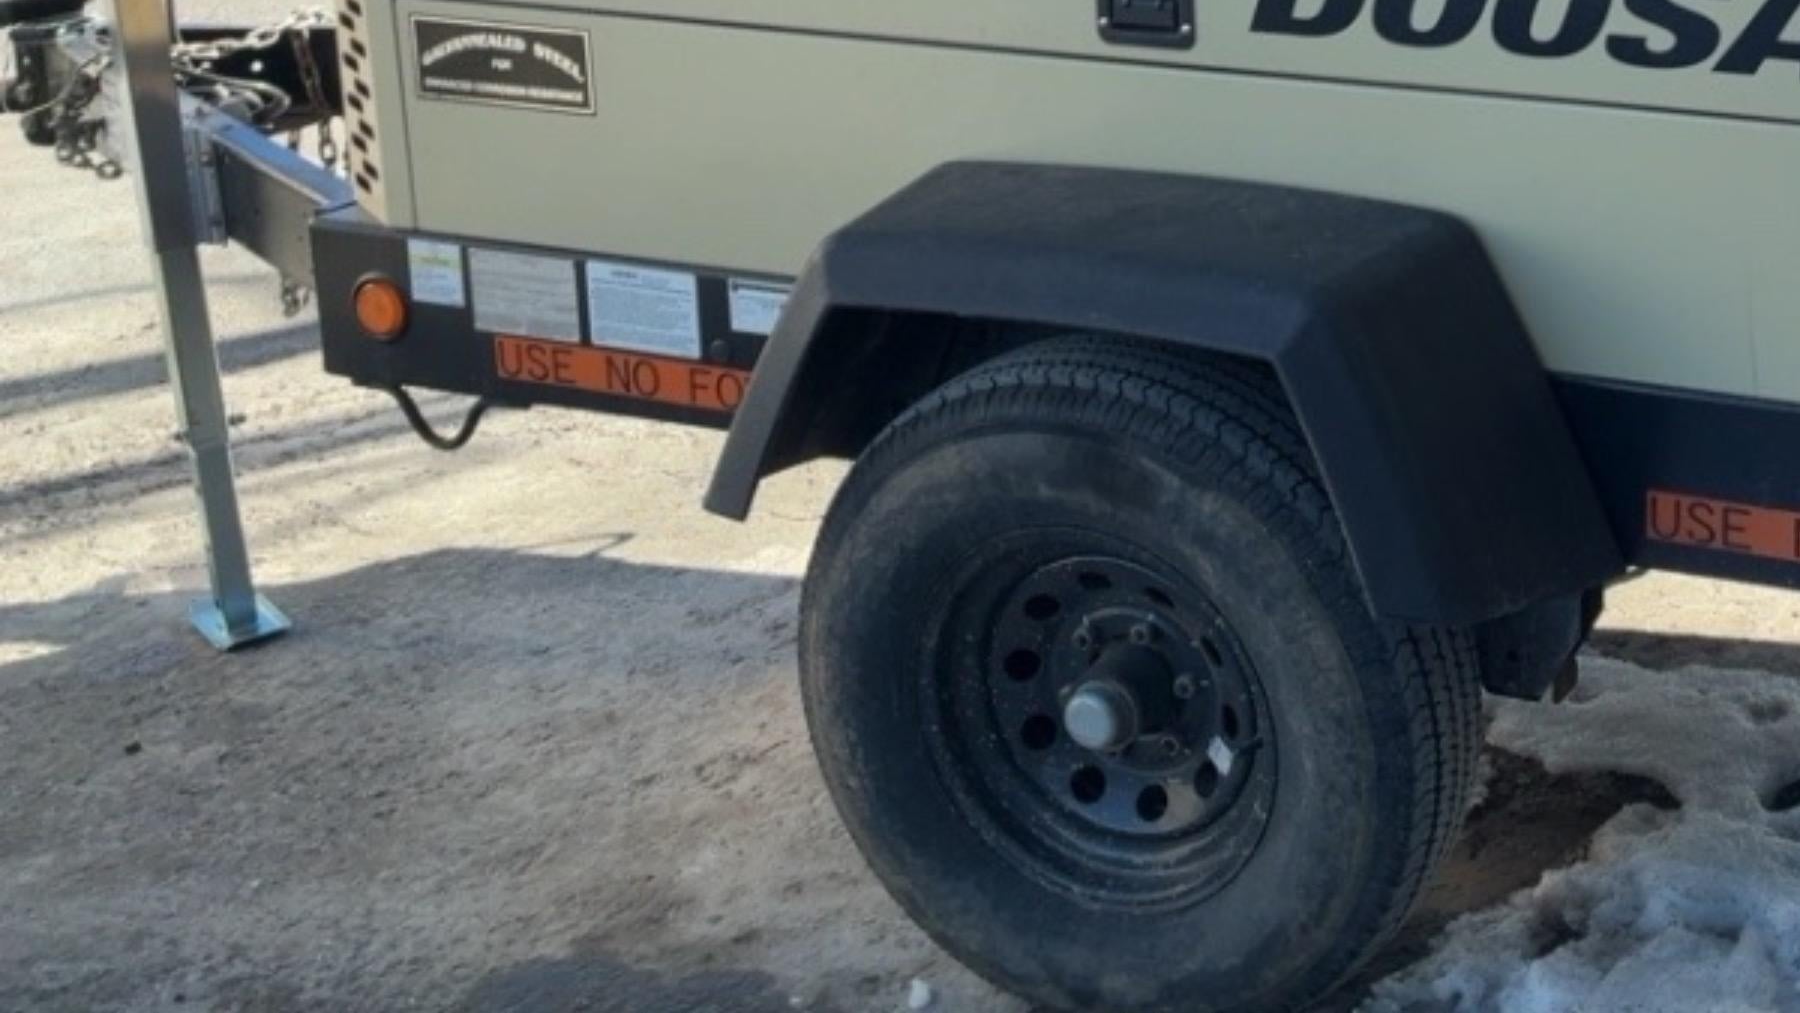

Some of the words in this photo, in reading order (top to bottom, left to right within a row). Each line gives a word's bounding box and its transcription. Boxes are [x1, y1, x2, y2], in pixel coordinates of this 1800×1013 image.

[498, 343, 577, 385] USE
[605, 355, 661, 398] NO
[1650, 497, 1753, 550] USE
